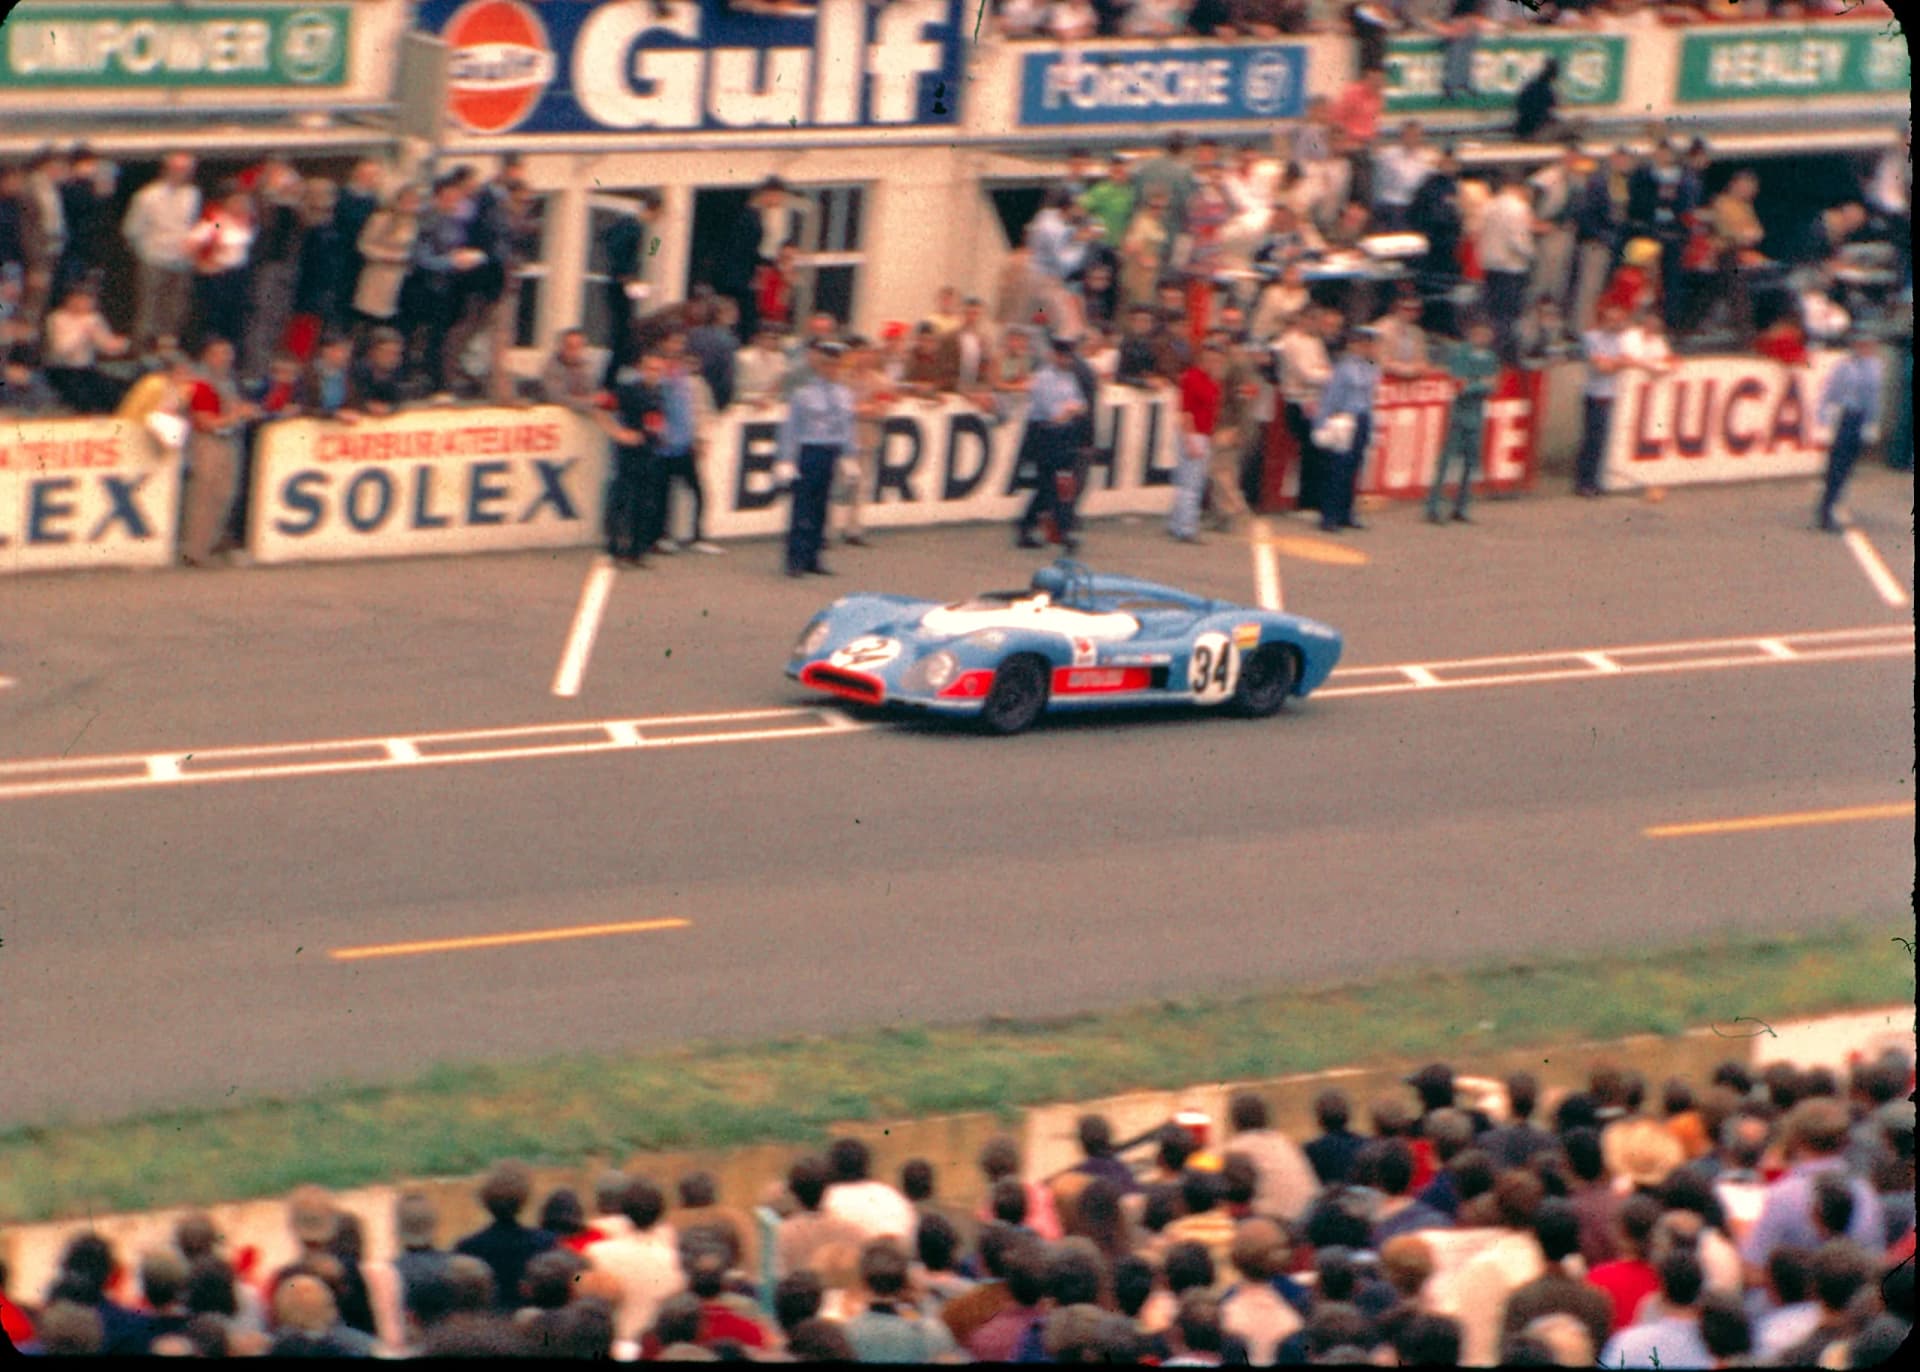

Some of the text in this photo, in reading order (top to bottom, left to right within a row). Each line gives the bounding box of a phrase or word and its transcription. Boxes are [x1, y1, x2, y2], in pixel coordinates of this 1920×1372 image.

[571, 0, 948, 128] Gulf
[1043, 58, 1231, 109] PORSCHE
[733, 396, 1172, 514] BRDHL
[1631, 374, 1828, 462] LUCA
[0, 471, 156, 545] EX
[274, 452, 580, 537] SOLEX
[1193, 641, 1230, 694] 34
